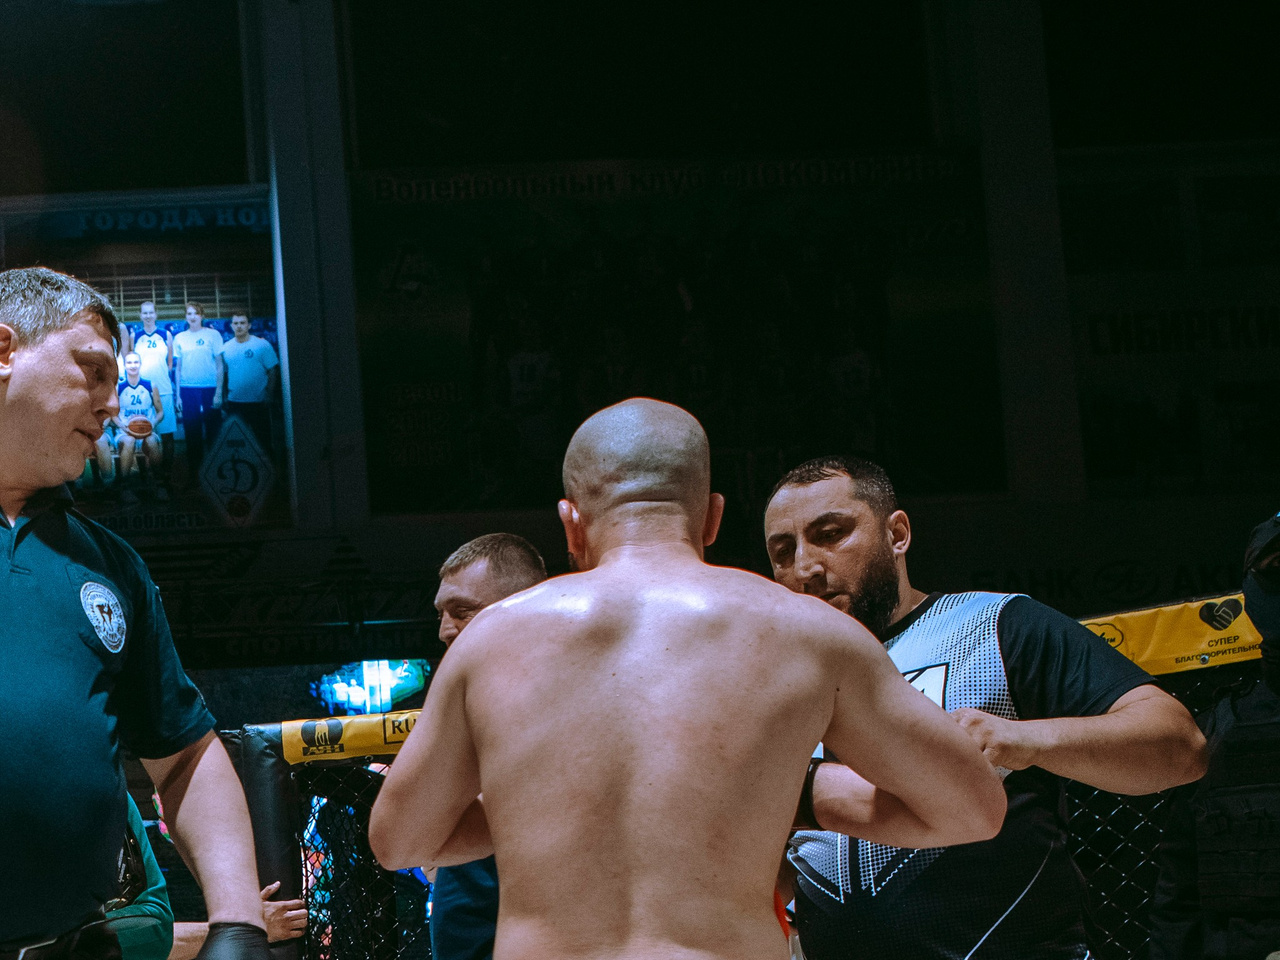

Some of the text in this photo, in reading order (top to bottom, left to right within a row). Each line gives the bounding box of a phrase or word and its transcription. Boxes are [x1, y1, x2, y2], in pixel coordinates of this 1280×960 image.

[77, 206, 202, 232] ГОРОДА
[146, 339, 158, 349] 26
[130, 394, 143, 406] 24
[1207, 635, 1240, 648] СУПЕР
